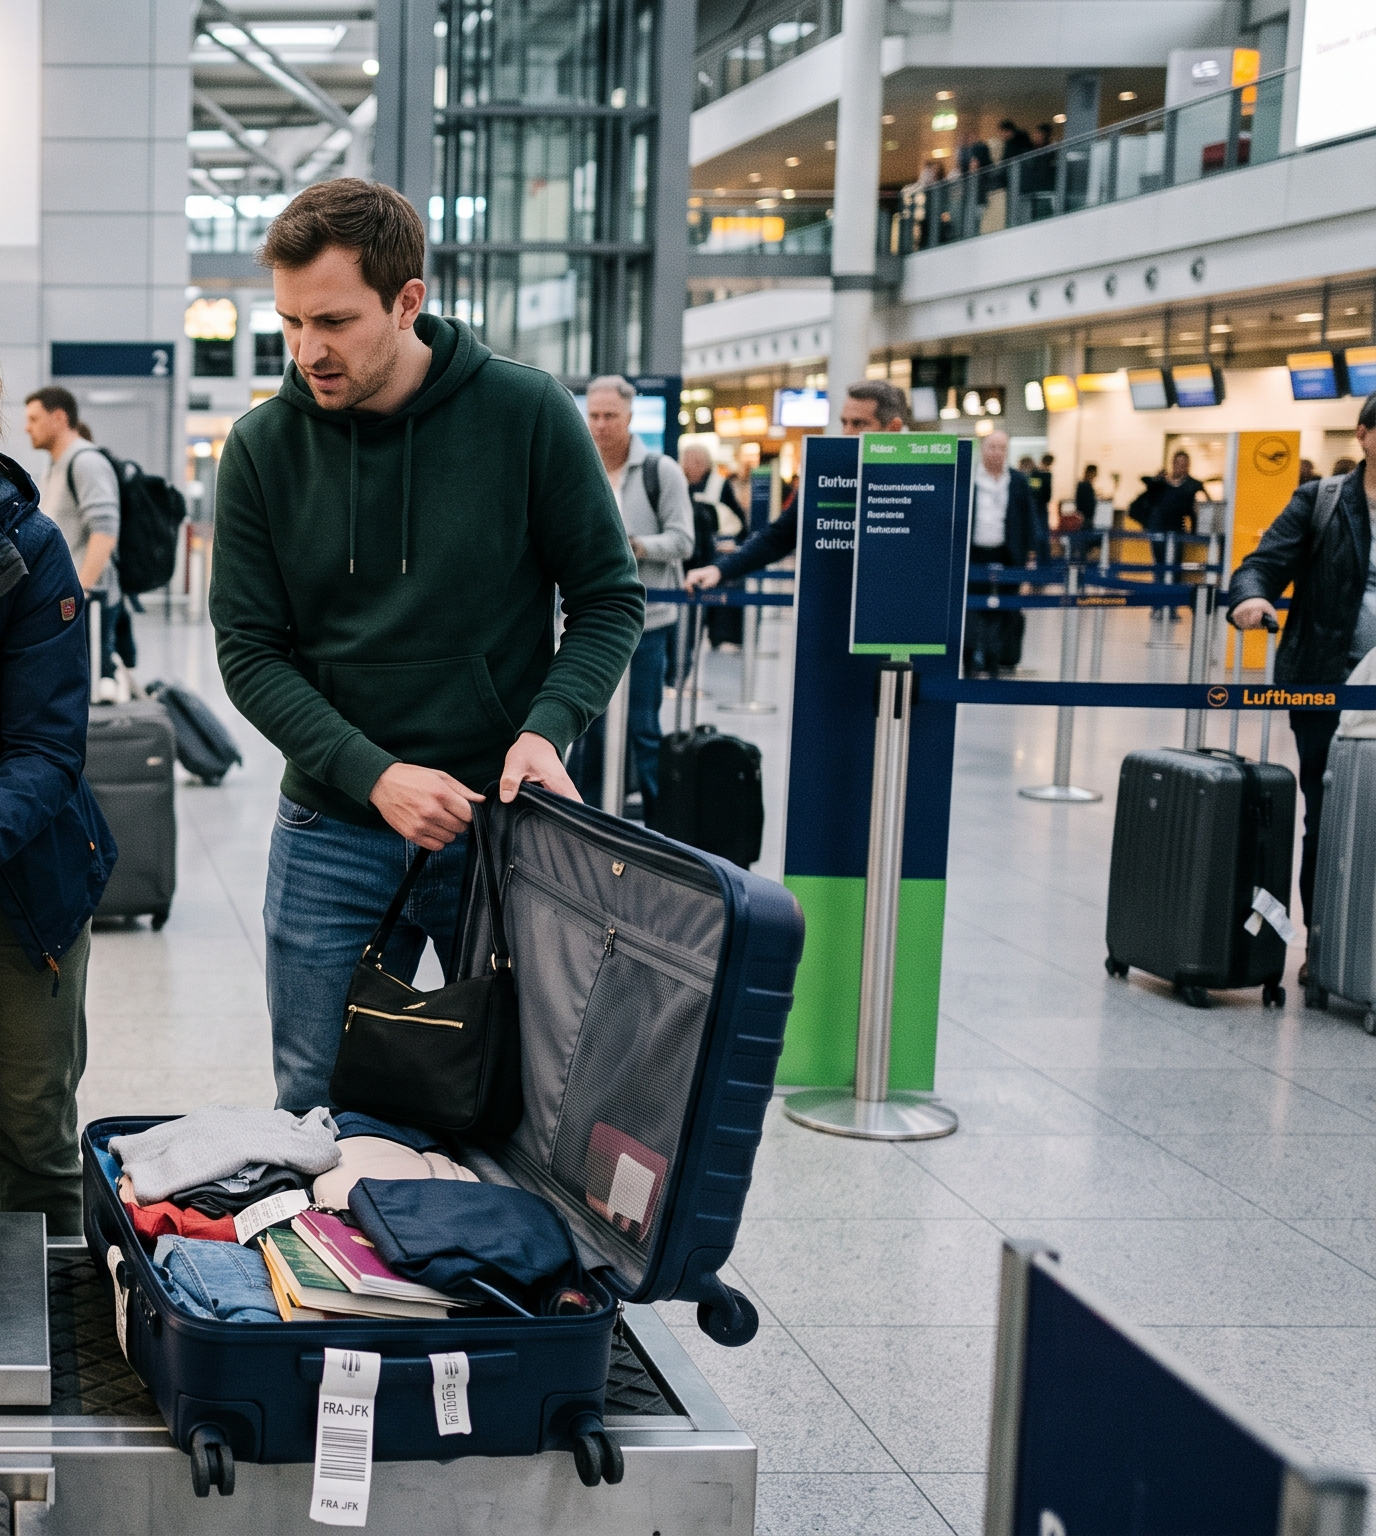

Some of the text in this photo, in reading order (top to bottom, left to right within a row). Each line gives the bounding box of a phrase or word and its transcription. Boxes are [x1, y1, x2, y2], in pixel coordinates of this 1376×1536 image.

[151, 349, 169, 376] 2
[1243, 689, 1336, 705] Lufthansa
[323, 1401, 369, 1418] FRA-JFK
[320, 1499, 359, 1511] FRA JFK
